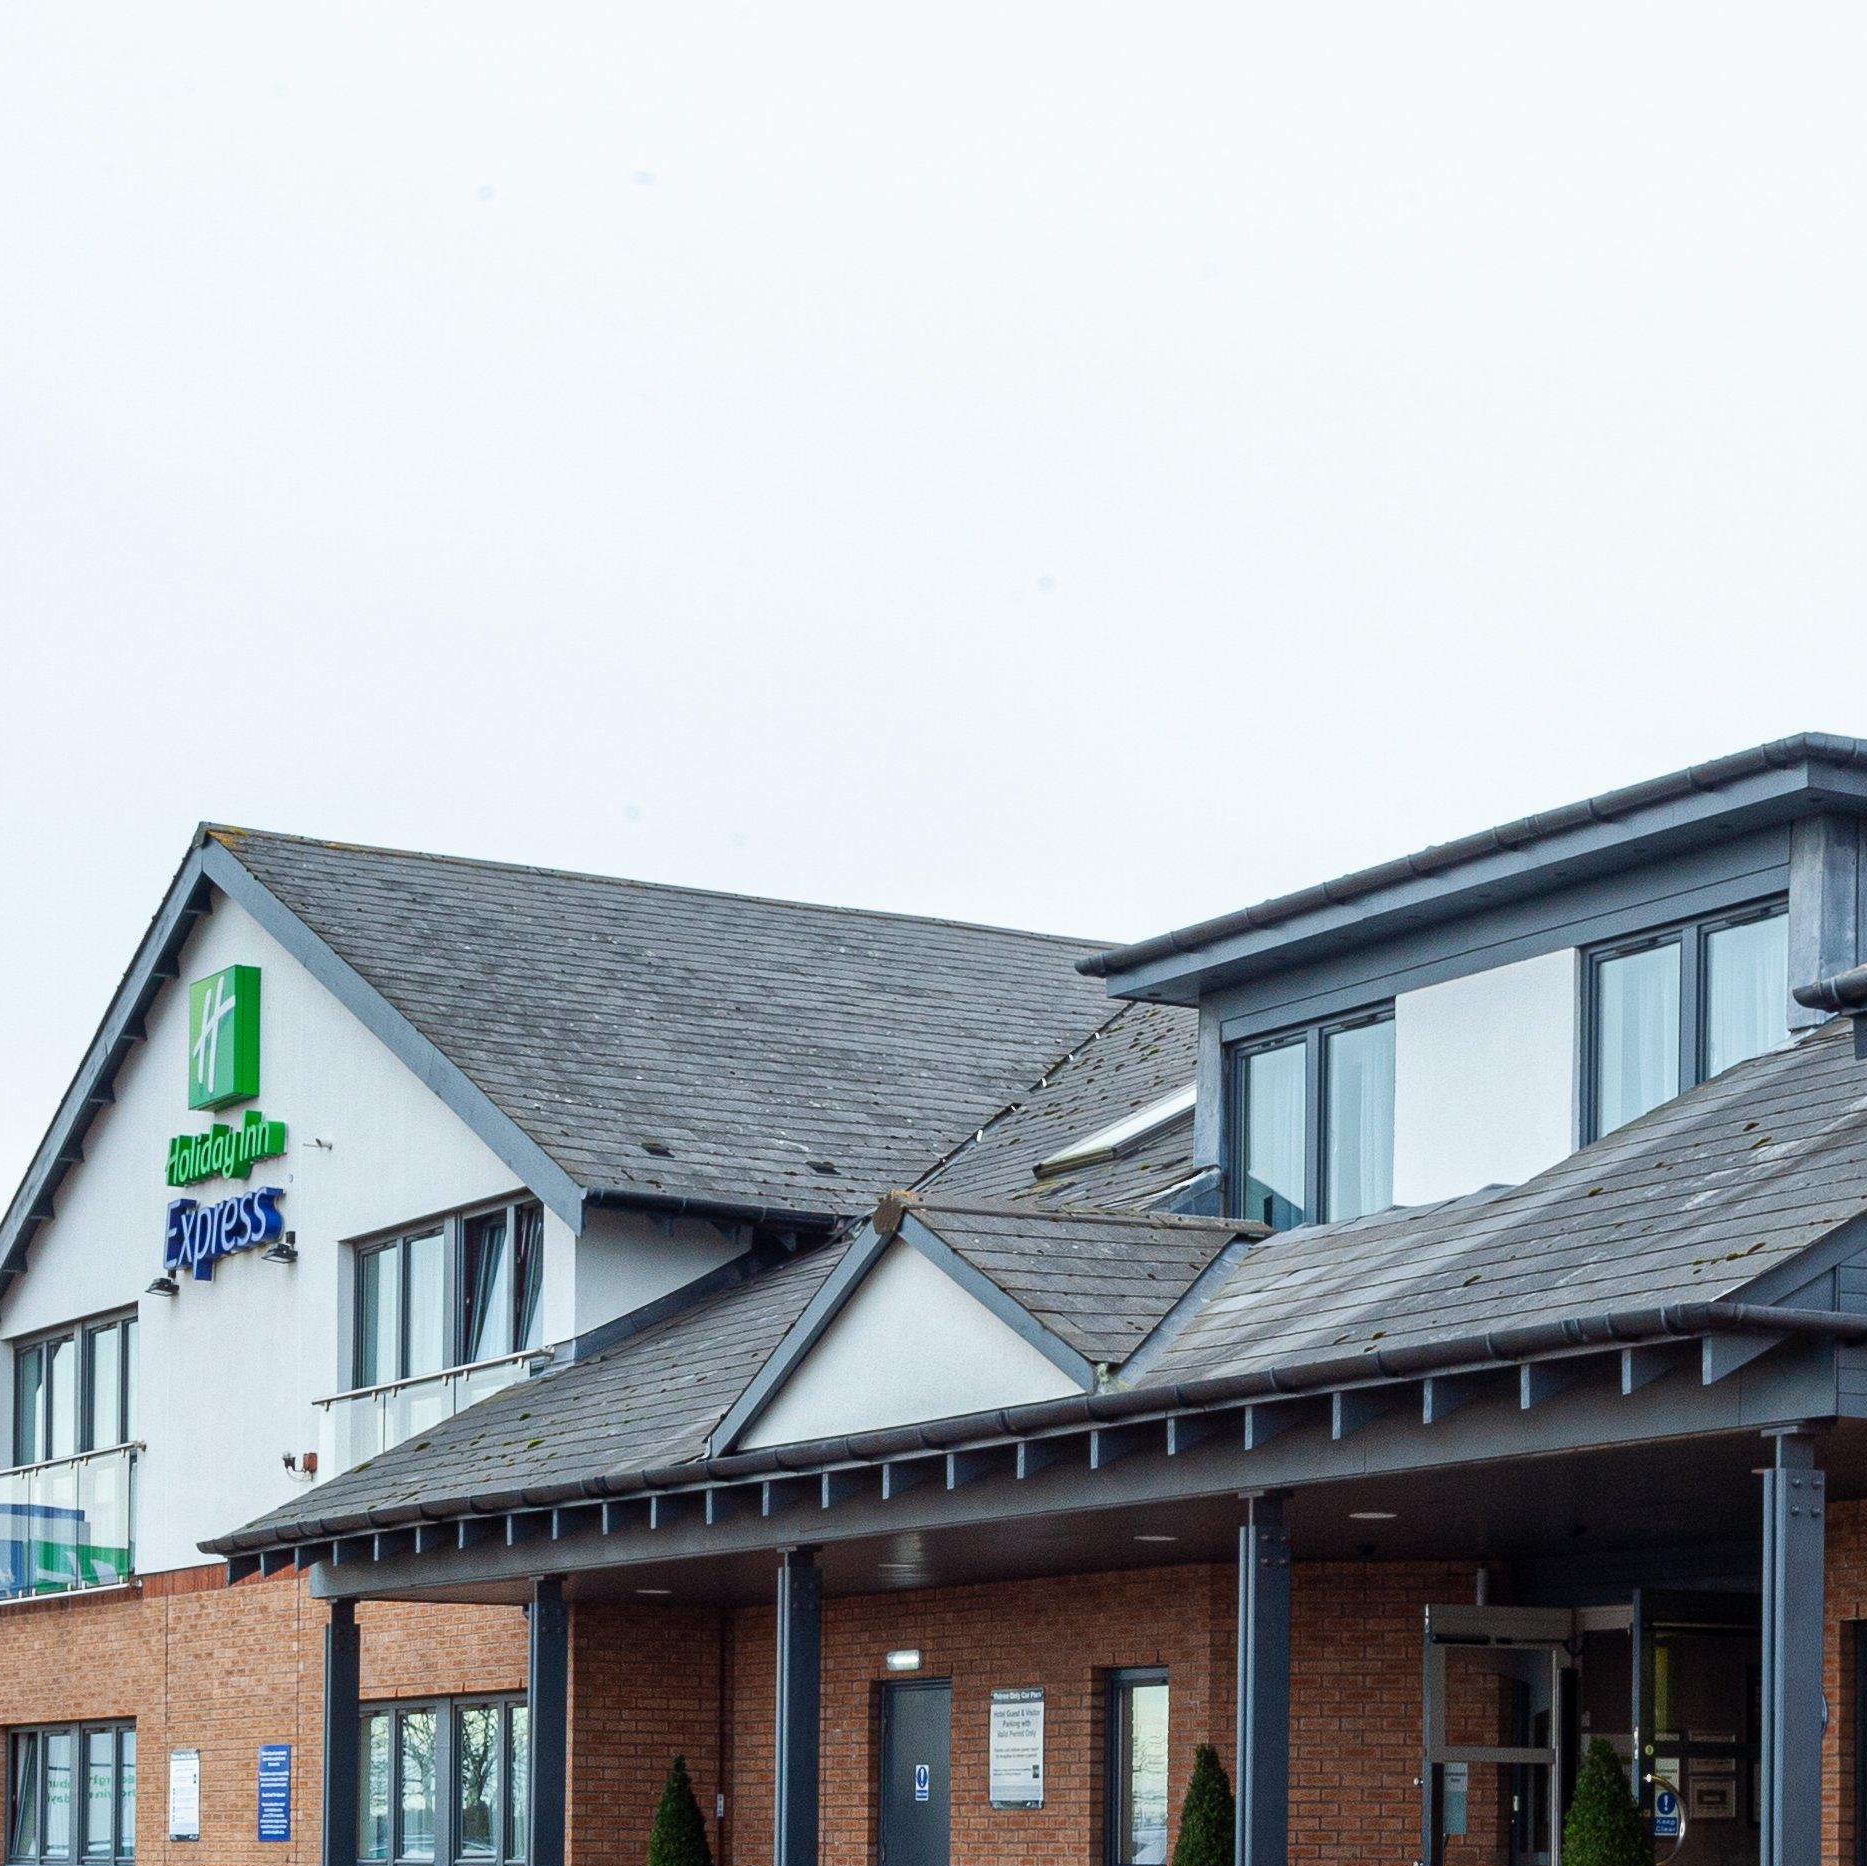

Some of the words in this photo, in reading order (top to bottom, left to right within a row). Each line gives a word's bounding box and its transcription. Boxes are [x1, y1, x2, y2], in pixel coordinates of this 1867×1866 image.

[165, 1125, 235, 1187] Holiday
[238, 1114, 279, 1167] Inn
[163, 1187, 279, 1276] Express
[1656, 1818, 1676, 1826] Keep
